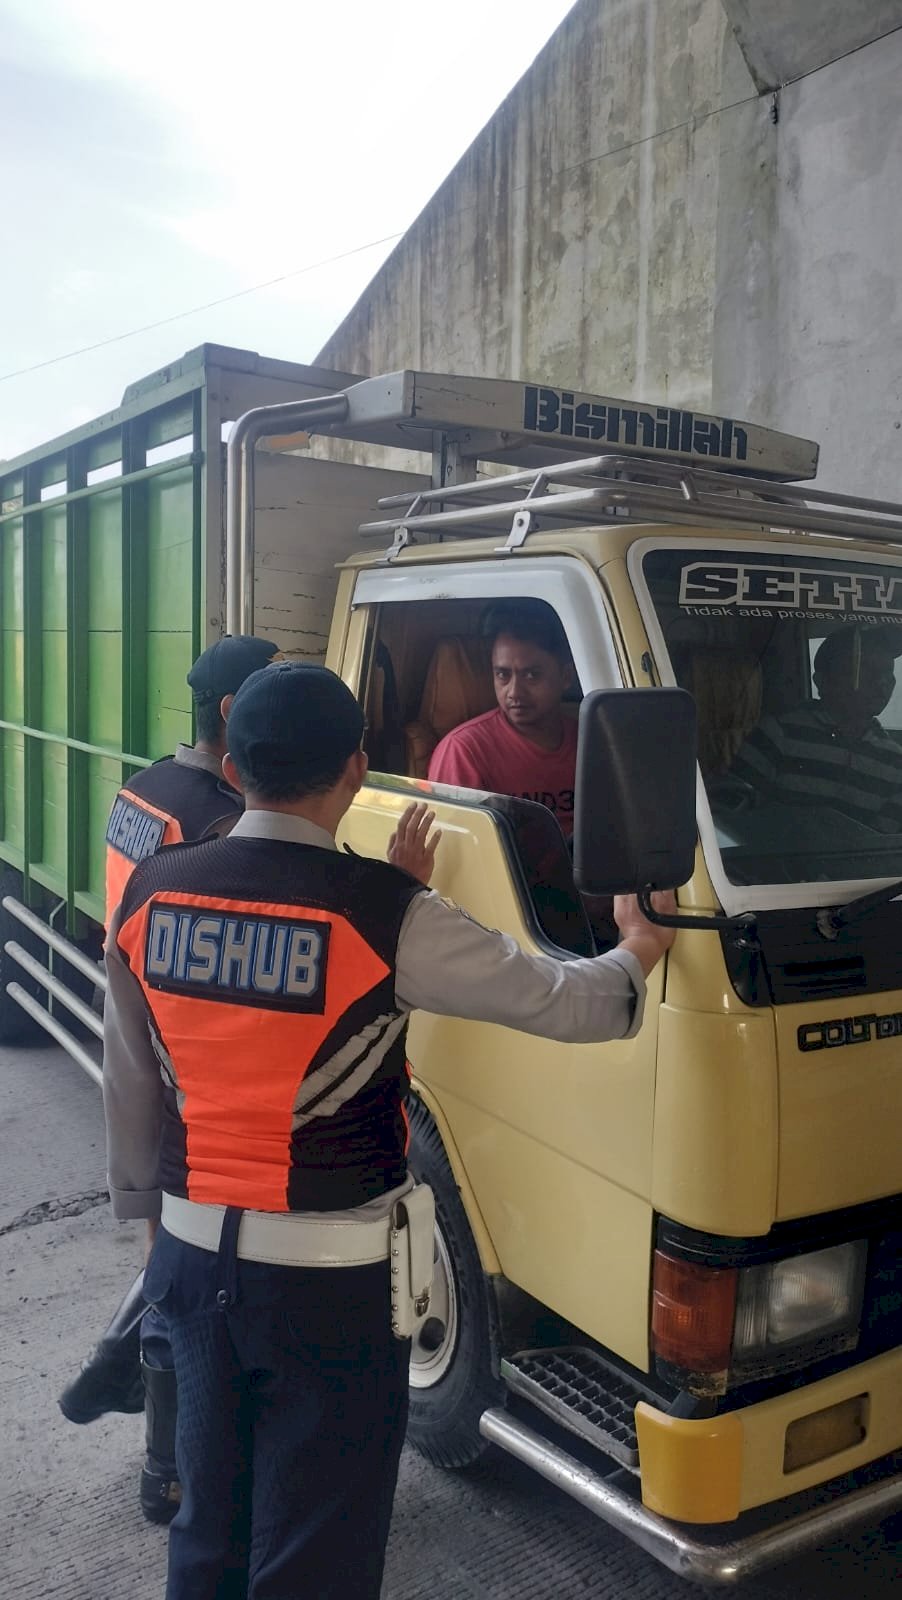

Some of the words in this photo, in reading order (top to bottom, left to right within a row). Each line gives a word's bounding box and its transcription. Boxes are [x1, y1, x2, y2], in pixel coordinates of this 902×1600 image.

[524, 386, 748, 461] Bismillah
[683, 606, 733, 618] Tidak
[739, 607, 773, 618] ada
[777, 609, 835, 620] proses
[838, 613, 878, 625] yang
[107, 798, 163, 862] DISHUB
[147, 910, 322, 997] DISHUB
